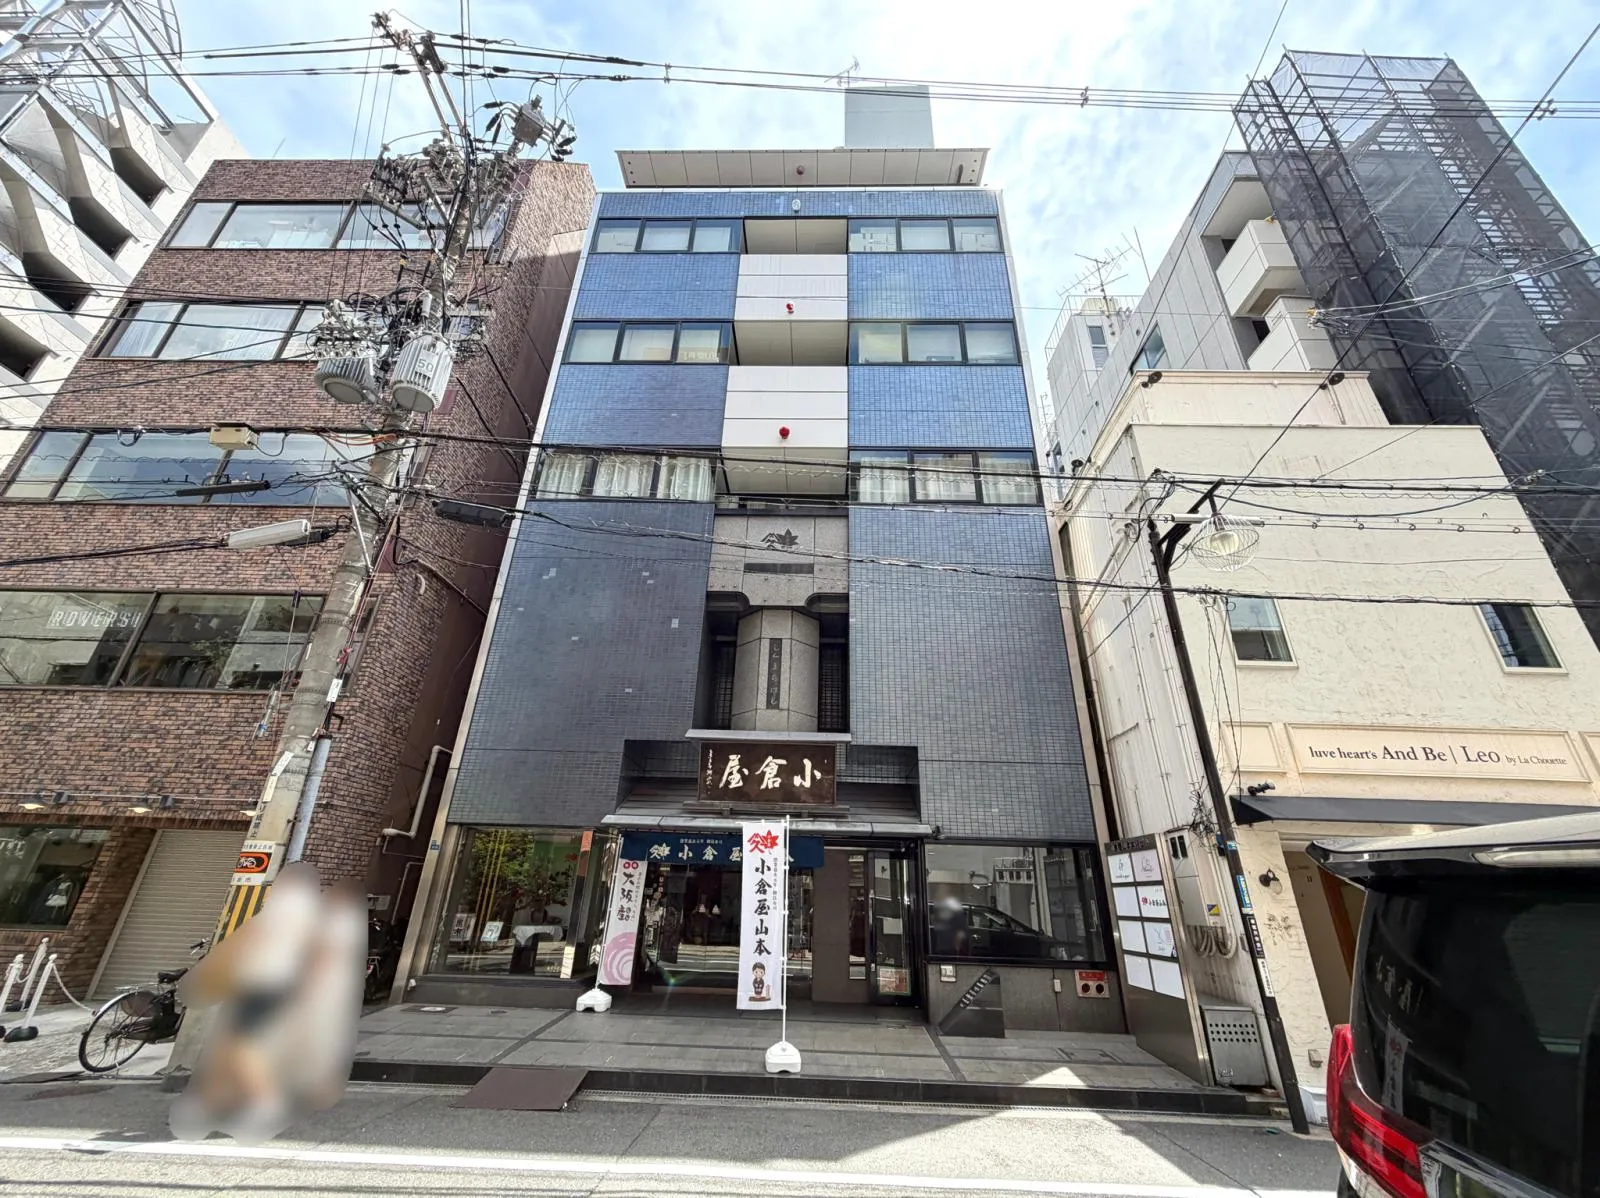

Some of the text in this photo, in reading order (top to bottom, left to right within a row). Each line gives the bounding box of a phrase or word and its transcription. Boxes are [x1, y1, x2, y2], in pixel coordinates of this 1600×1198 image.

[418, 358, 434, 372] 50
[1308, 746, 1336, 758] luve
[1336, 747, 1378, 760] heart's
[1382, 745, 1418, 761] And
[1421, 746, 1448, 762] Be
[1460, 746, 1501, 763] Leo
[1505, 755, 1517, 766] by
[1518, 756, 1530, 764] La
[718, 754, 822, 791] 小倉屋
[753, 858, 772, 957] 小倉屋山本
